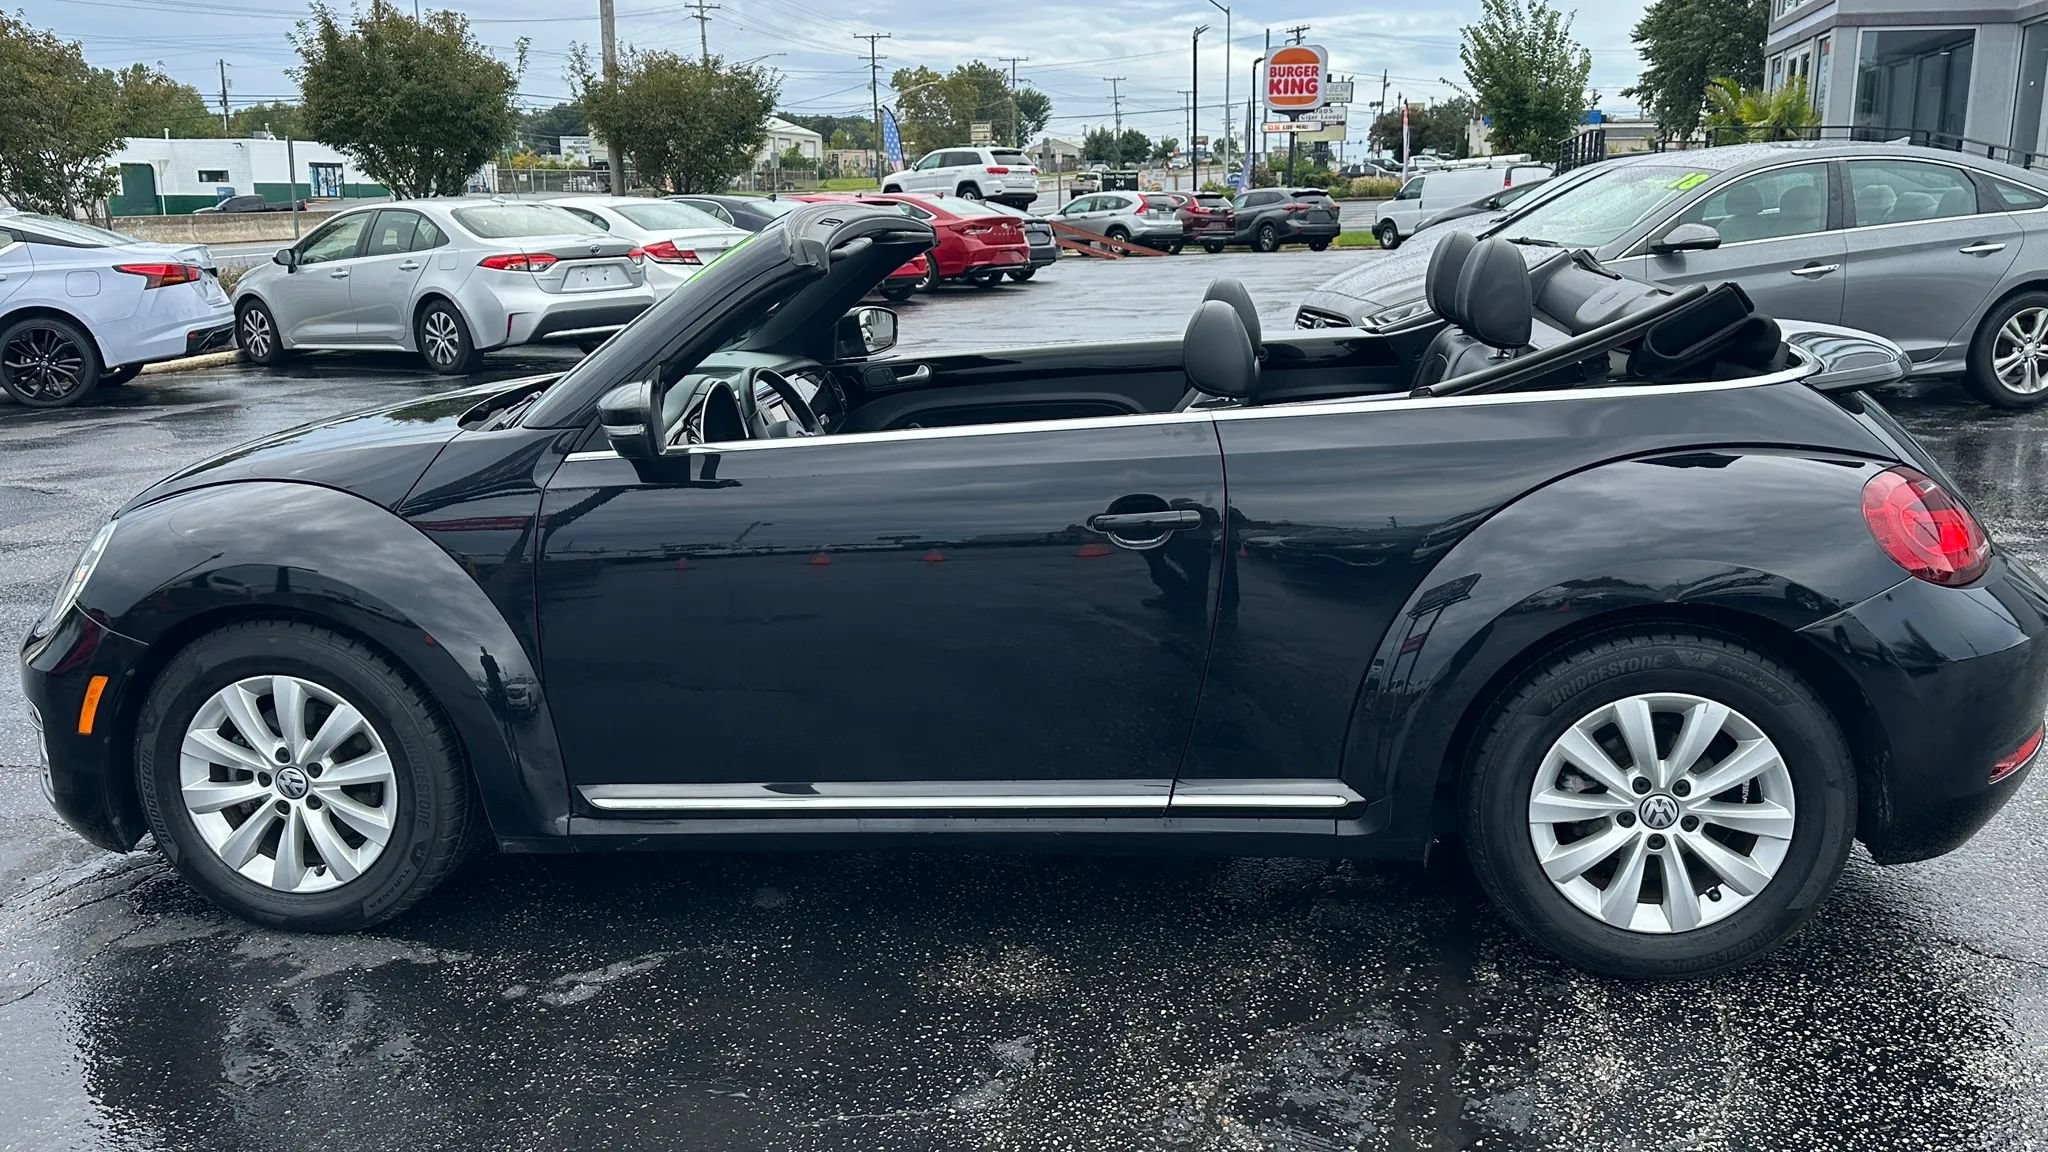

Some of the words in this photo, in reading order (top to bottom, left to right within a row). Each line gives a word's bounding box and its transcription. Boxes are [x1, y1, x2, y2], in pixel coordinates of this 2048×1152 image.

[1269, 65, 1319, 78] BURGER
[1268, 78, 1318, 95] KING
[1115, 179, 1124, 187] 24
[1667, 172, 1709, 190] 18
[1547, 654, 1664, 710] BRIDGESTONE
